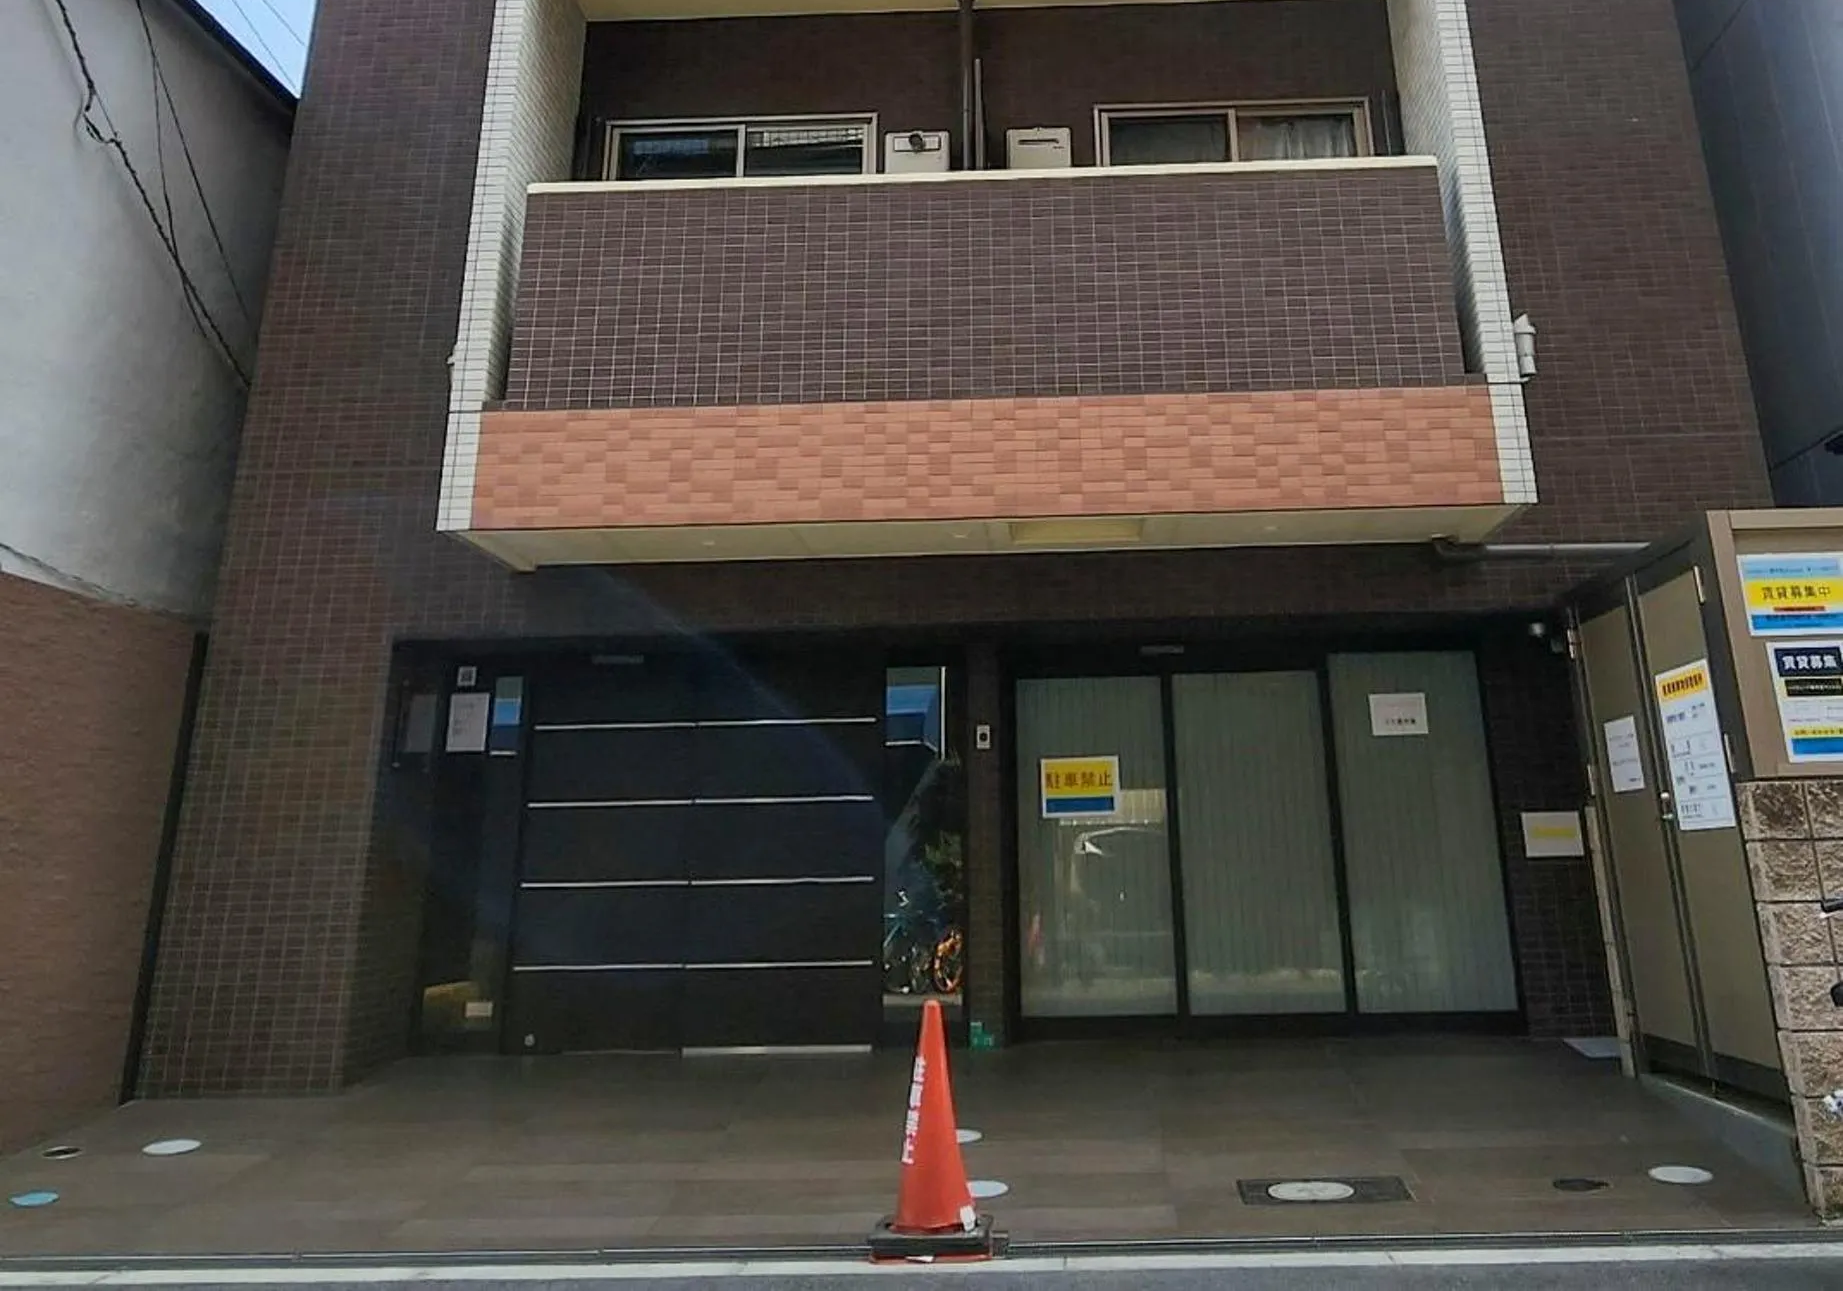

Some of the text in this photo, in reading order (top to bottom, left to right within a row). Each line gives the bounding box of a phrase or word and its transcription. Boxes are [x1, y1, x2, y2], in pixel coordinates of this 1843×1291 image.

[1762, 585, 1832, 601] 賃貸募集中
[1045, 770, 1115, 789] 駐車禁止
